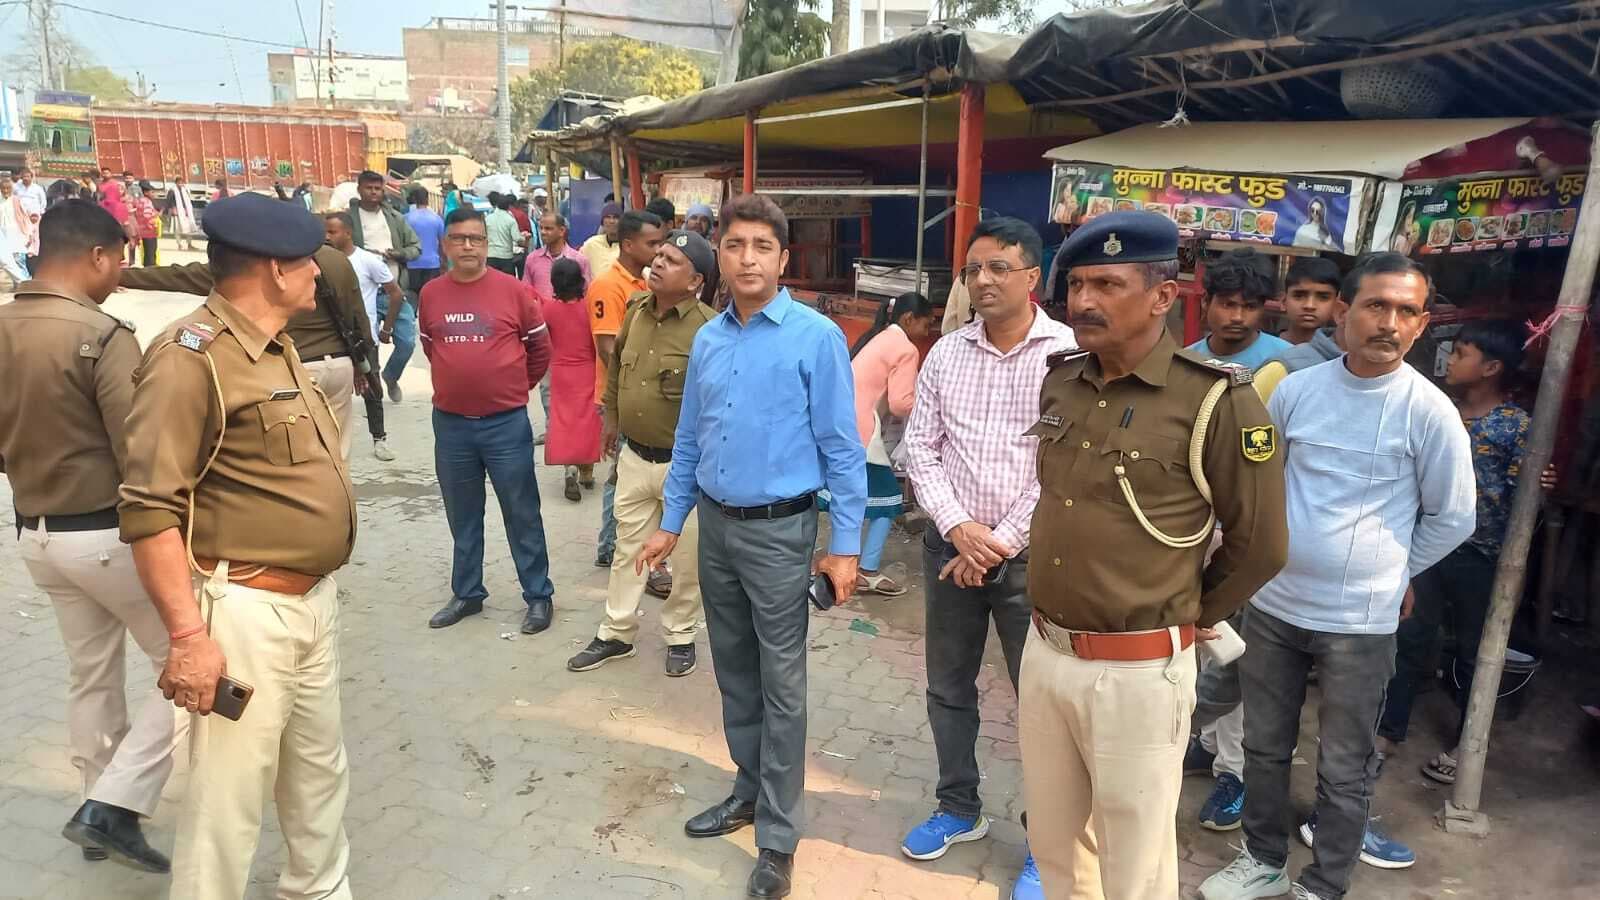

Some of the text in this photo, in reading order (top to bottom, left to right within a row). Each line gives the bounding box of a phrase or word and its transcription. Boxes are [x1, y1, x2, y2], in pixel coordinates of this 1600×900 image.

[1112, 168, 1166, 196] मुन्ना
[1171, 171, 1235, 194] फास्ट
[1239, 176, 1288, 208] फुड
[1457, 179, 1504, 213] मुन्ना
[1507, 176, 1550, 198] फास्ट
[444, 313, 475, 323] WILD
[595, 300, 604, 319] 3
[472, 335, 484, 343] 21
